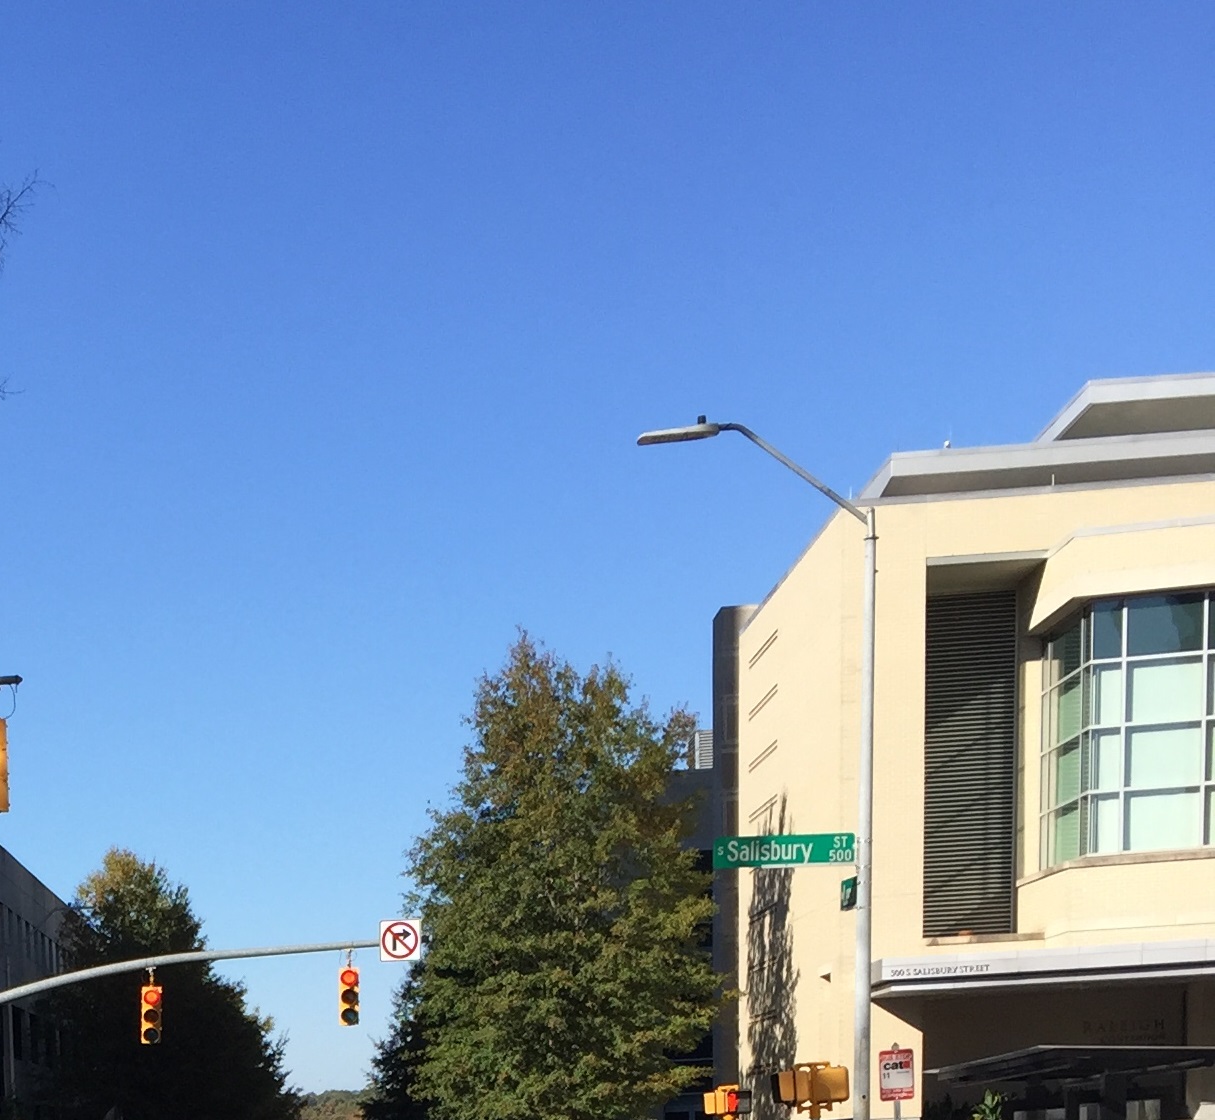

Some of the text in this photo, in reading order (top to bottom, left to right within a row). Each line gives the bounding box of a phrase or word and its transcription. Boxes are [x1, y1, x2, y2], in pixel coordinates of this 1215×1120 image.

[717, 836, 849, 864] S Salisbury ST
[828, 849, 852, 862] 500
[913, 966, 958, 976] SALISBURY
[959, 964, 990, 973] STREET
[883, 1061, 904, 1070] cat
